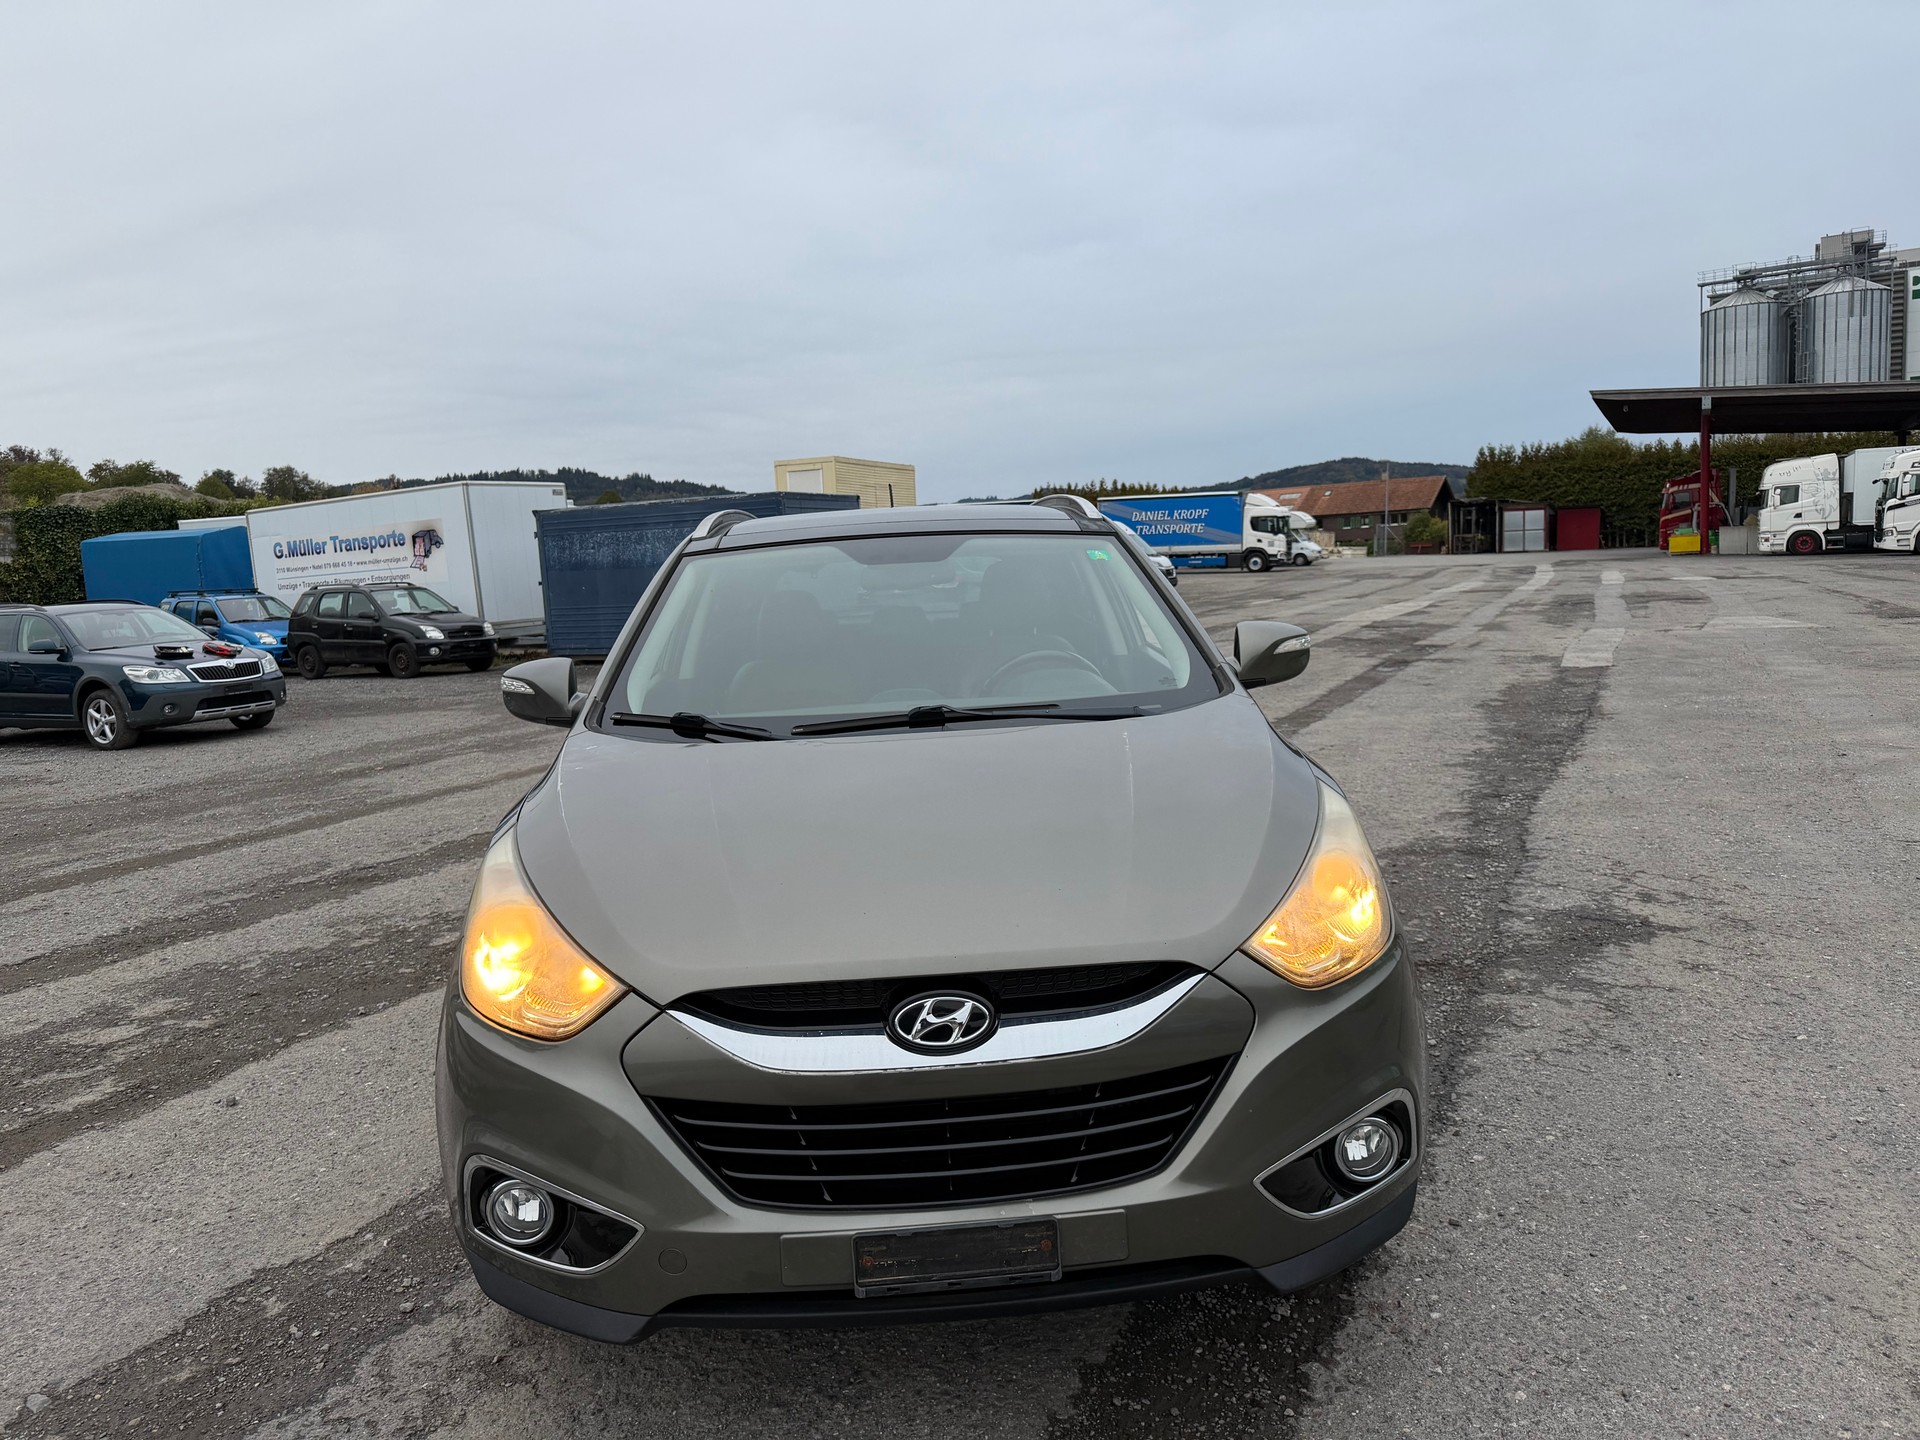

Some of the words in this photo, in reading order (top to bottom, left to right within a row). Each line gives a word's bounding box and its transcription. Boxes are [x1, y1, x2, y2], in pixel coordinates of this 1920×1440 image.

[1132, 510, 1171, 522] DANIEL
[1173, 508, 1209, 520] KROPF
[1136, 523, 1205, 535] TRANSPORTE
[273, 538, 327, 559] G.Müller
[329, 529, 406, 554] Transporte
[277, 583, 298, 591] Umzüge
[370, 574, 410, 583] Entsorgungen
